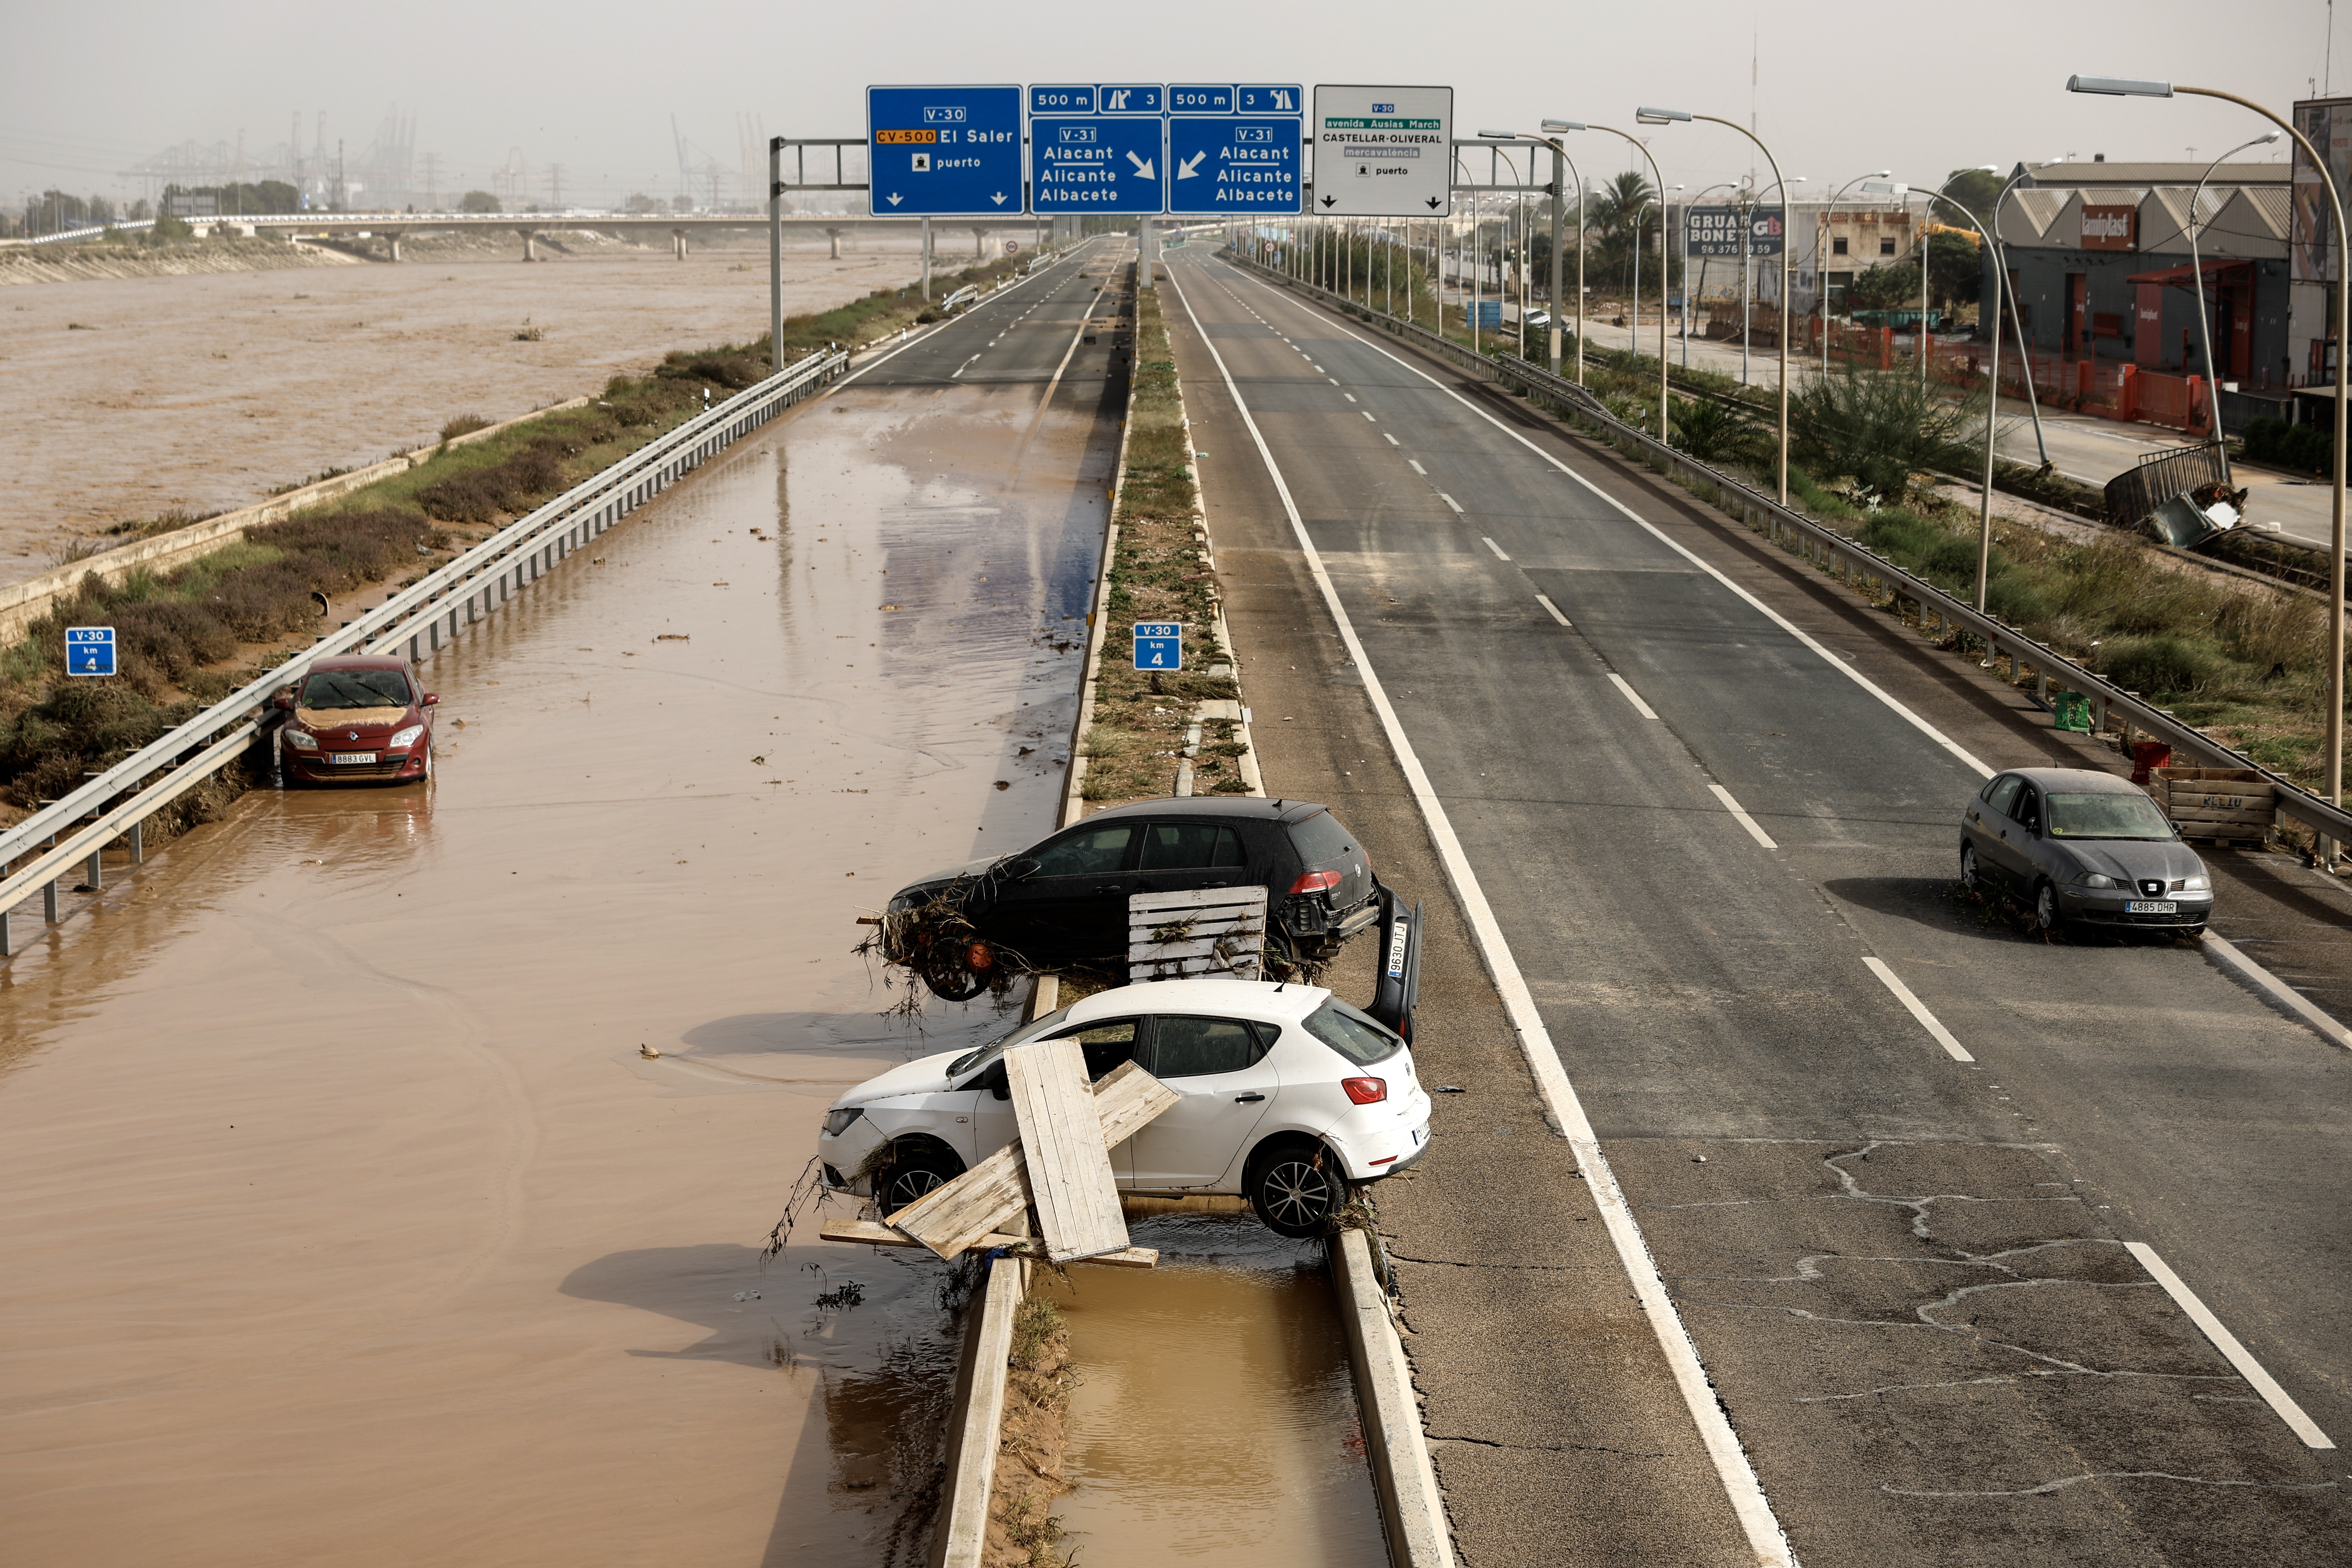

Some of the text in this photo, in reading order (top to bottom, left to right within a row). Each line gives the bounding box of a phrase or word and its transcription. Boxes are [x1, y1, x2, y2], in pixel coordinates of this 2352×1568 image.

[1039, 95, 1087, 105] 500 m
[1147, 94, 1155, 105] 3
[1177, 94, 1226, 105] 500 m
[1247, 94, 1255, 105] 3
[927, 110, 964, 120] V-30
[1326, 119, 1439, 129] avenida Ausias March
[878, 130, 1013, 143] CV-500 El Saler
[1063, 130, 1094, 141] V-31
[1239, 130, 1270, 140] V-31
[1323, 134, 1442, 144] CASTELLAR-OLIVERAL
[1044, 147, 1113, 160] Alacant
[1220, 147, 1289, 160] Alacant
[1346, 149, 1418, 157] mercavalència
[938, 158, 981, 170] puerto
[1042, 170, 1116, 183] Alicante
[1217, 170, 1292, 183] Alicante
[1377, 167, 1408, 176] puerto
[1040, 189, 1118, 201] Albacete
[1216, 189, 1293, 201] Albacete
[2082, 212, 2129, 243] lamiplast
[1701, 245, 1715, 254] 96
[1718, 245, 1738, 254] 376
[1757, 245, 1770, 254] 59
[76, 631, 104, 641] V-30
[1143, 626, 1171, 635] V-30
[83, 646, 98, 654] km
[85, 657, 97, 671] 4
[1151, 652, 1163, 666] 4
[359, 754, 374, 762] GVL
[2132, 902, 2174, 912] 4885 DHR
[1394, 926, 1405, 944] JTJ
[1391, 946, 1403, 971] 9630
